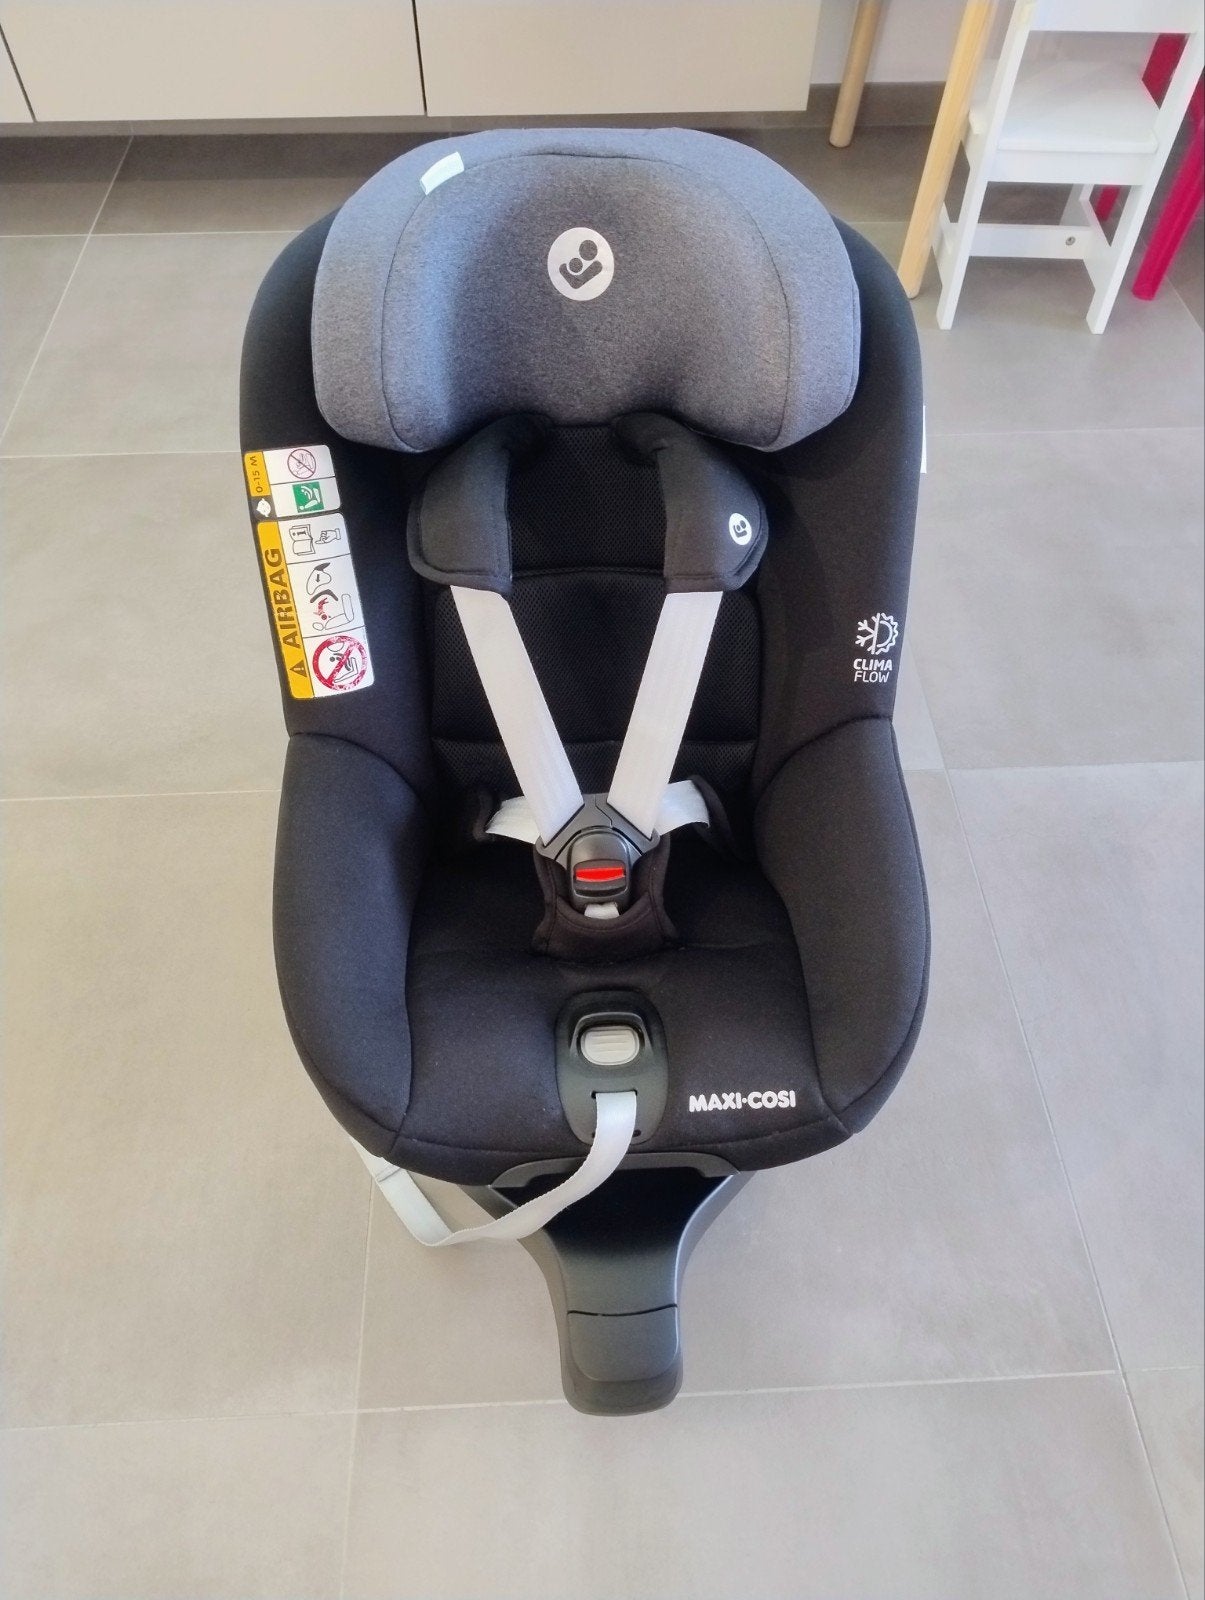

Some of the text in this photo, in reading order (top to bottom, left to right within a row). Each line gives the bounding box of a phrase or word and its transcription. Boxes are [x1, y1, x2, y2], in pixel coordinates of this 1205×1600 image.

[264, 548, 301, 649] AIRBAG
[853, 658, 893, 671] CLIMA
[853, 670, 890, 683] FLOW
